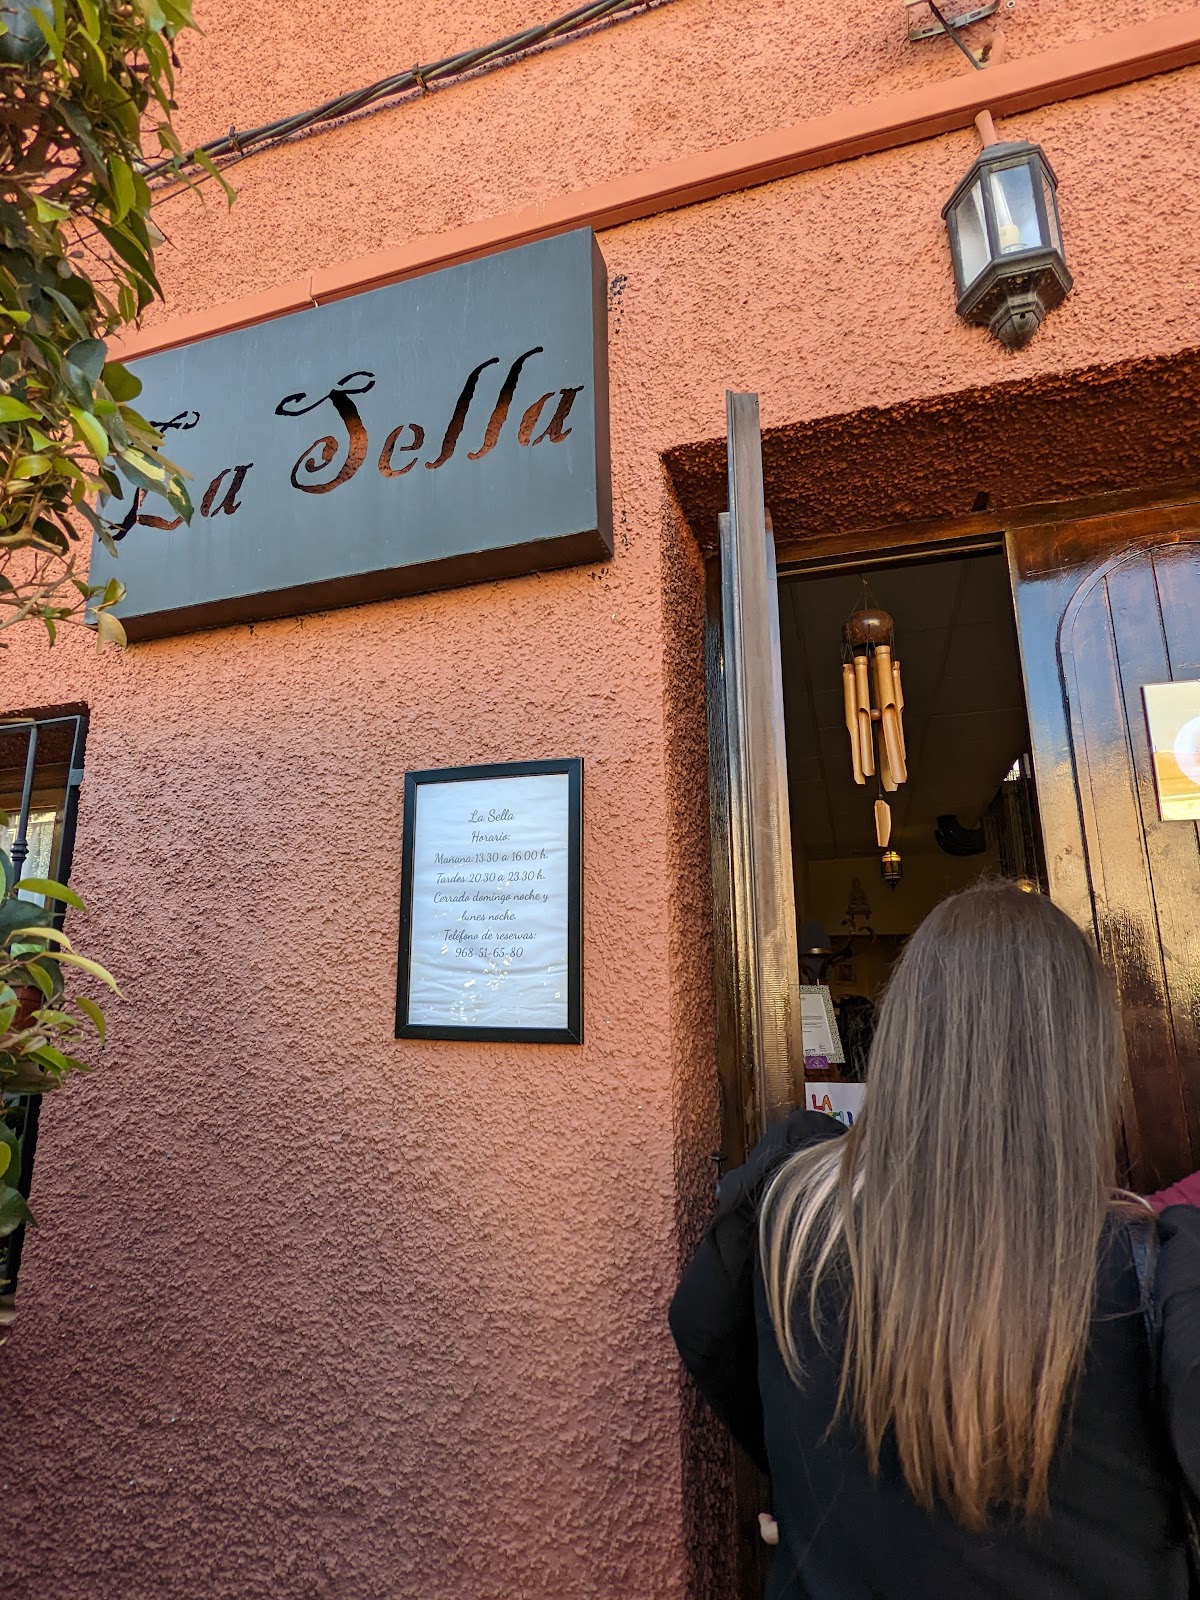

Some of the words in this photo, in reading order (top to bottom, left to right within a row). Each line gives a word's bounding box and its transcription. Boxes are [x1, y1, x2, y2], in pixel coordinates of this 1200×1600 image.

[274, 346, 585, 495] Sella
[468, 810, 485, 823] La
[488, 808, 515, 822] Sella
[471, 831, 511, 843] Horario:
[501, 854, 509, 862] a
[511, 850, 538, 862] 16.00
[540, 848, 549, 860] h.
[497, 874, 505, 882] a
[507, 871, 535, 882] 23.30
[537, 869, 546, 880] h.
[433, 891, 470, 904] Cerrado
[472, 891, 512, 905] domingo
[513, 889, 541, 901] noche
[542, 893, 550, 903] y
[461, 910, 486, 921] lunes
[488, 909, 517, 921] noche.
[444, 929, 479, 944] Teléfono
[481, 929, 493, 940] de
[495, 932, 537, 941] reservas:
[455, 947, 524, 958] 968-51-65-80
[811, 1093, 833, 1112] LA
